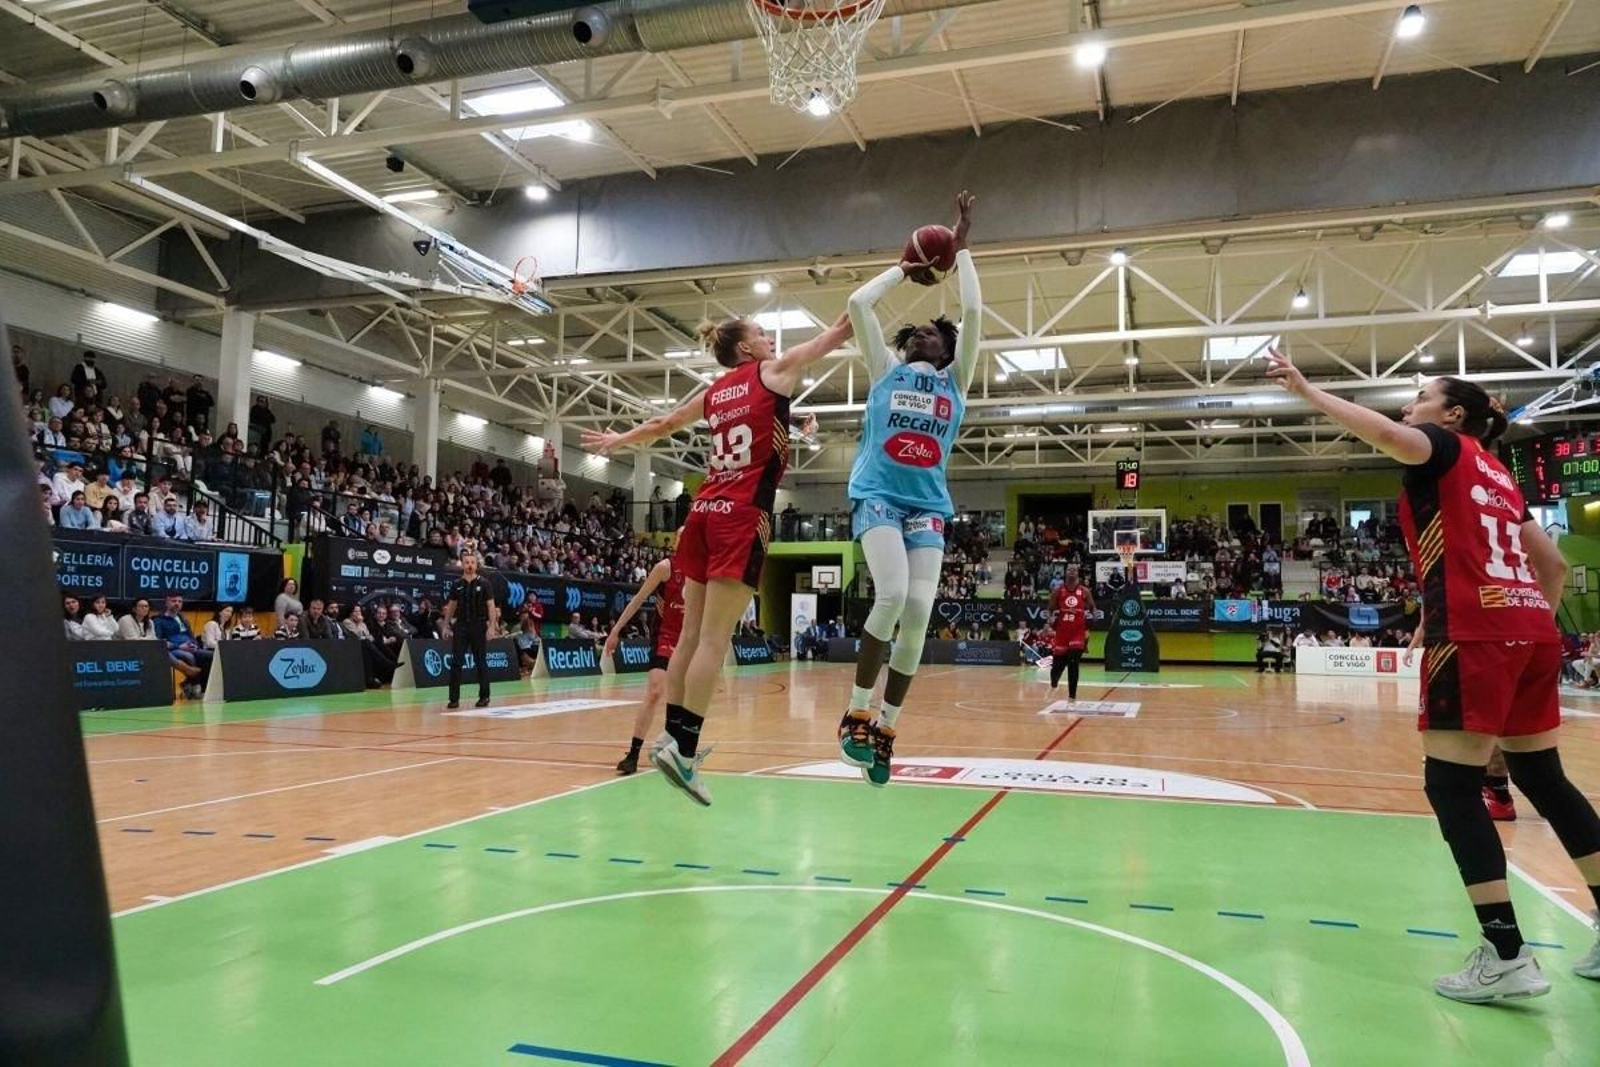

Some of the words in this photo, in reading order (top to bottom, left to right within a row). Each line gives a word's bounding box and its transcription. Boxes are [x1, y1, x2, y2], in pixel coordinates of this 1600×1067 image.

[711, 382, 749, 406] FIEBICH
[893, 393, 932, 405] CONCELLO
[909, 402, 928, 410] VIGO
[887, 412, 950, 438] Recalvi
[711, 423, 752, 470] 13
[1563, 459, 1599, 475] 07:00
[1480, 512, 1536, 583] 11
[131, 557, 209, 574] CONCELLO
[140, 575, 160, 588] DE
[165, 576, 200, 590] VIGO
[1507, 597, 1522, 607] DE
[548, 646, 596, 669] Recalvi
[734, 644, 767, 661] Vepersa
[76, 661, 103, 673] DEL
[106, 660, 141, 672] BENE
